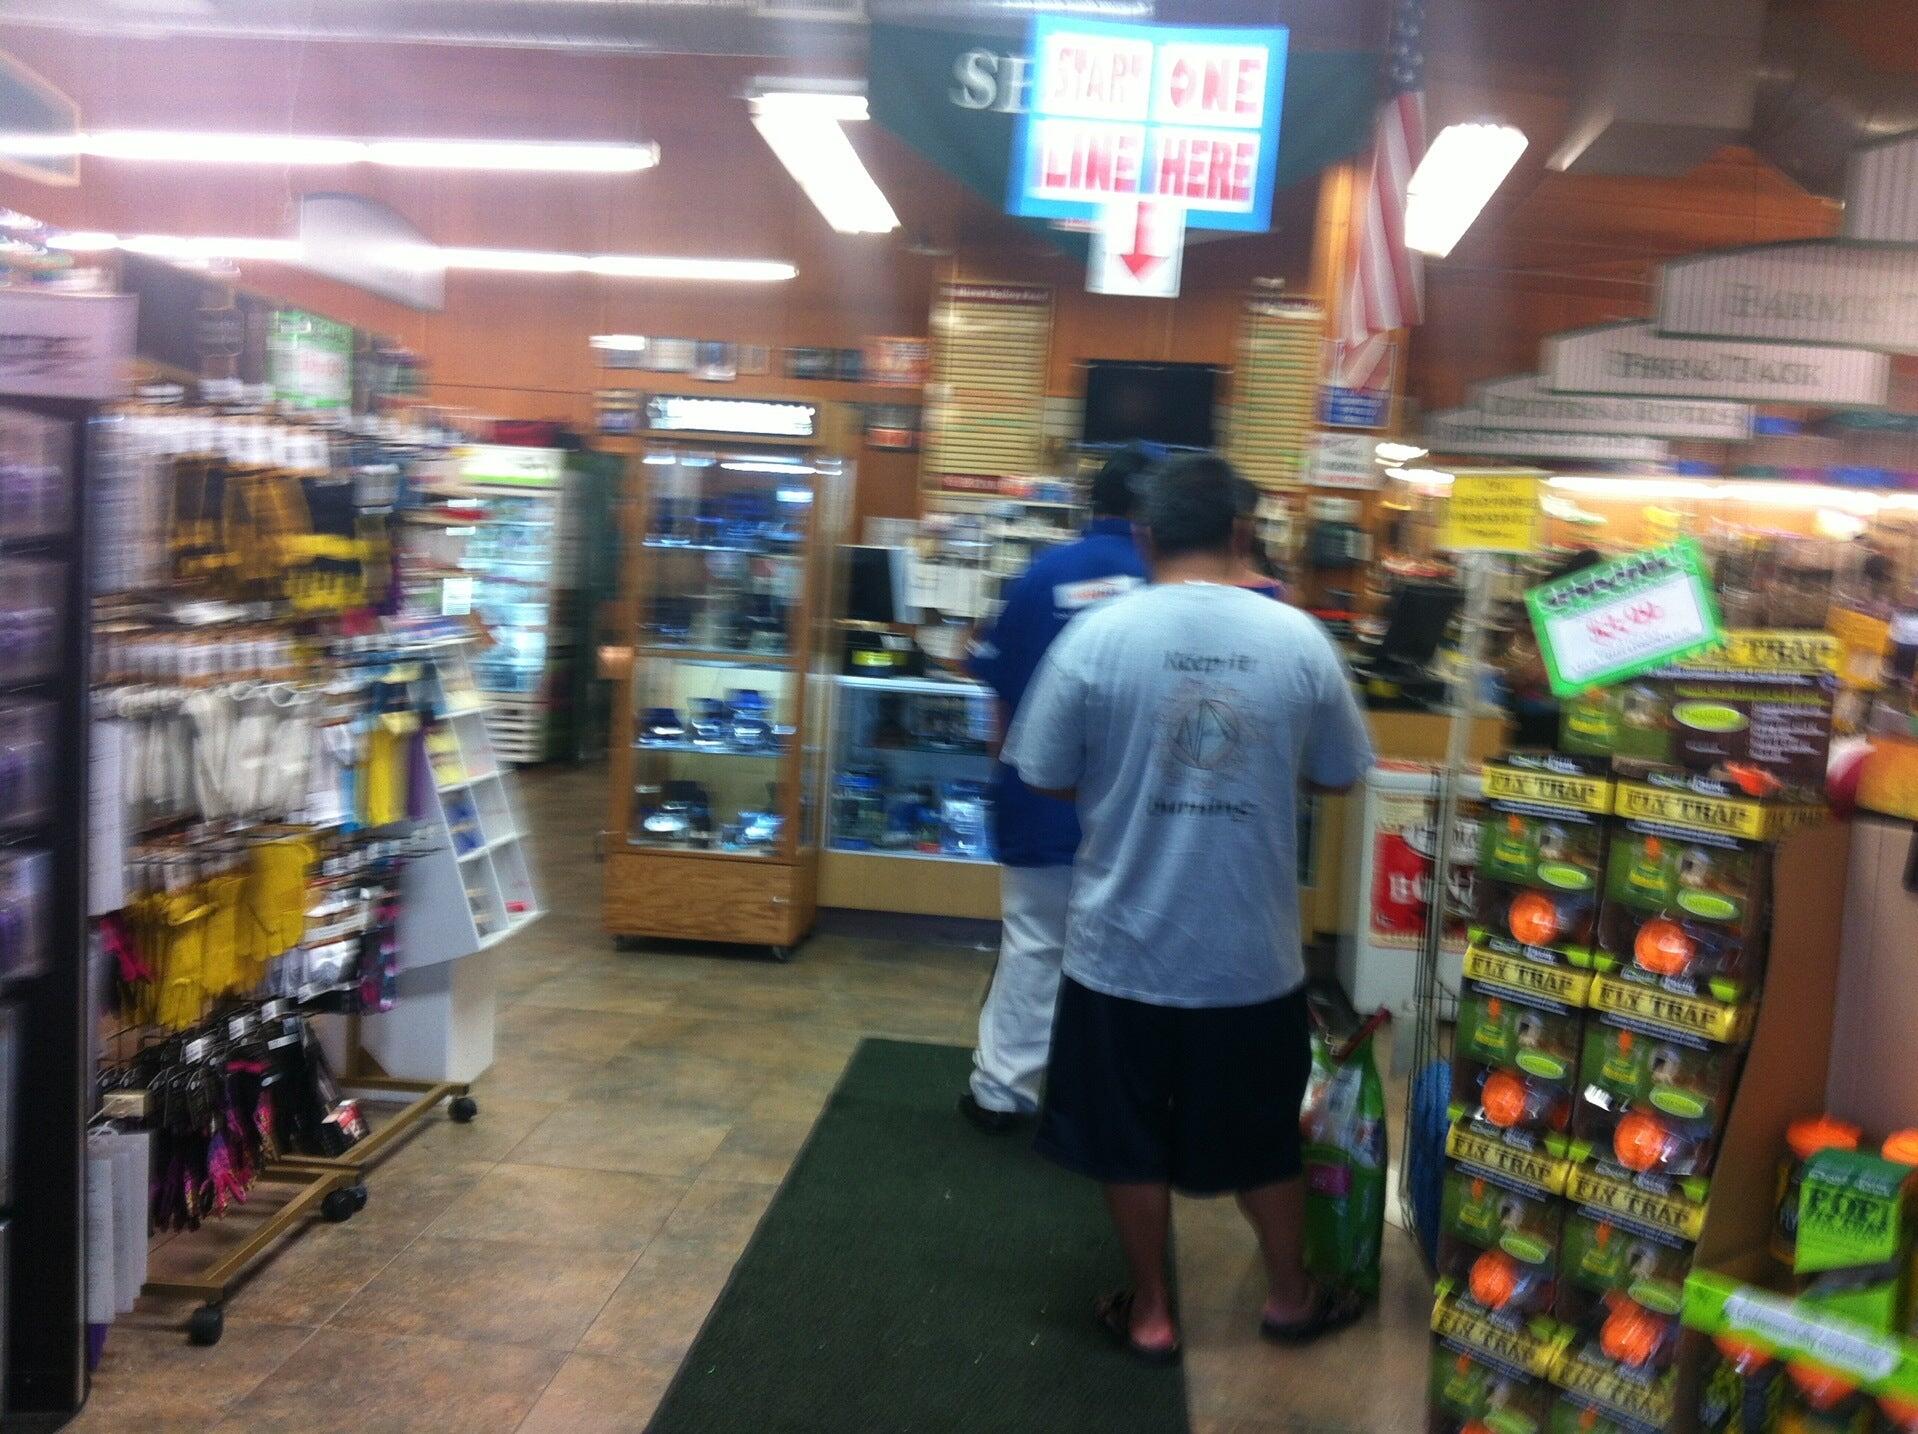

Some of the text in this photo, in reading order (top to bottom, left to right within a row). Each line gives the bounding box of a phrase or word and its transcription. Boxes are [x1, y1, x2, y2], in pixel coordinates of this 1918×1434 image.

[1169, 58, 1261, 114] ONE
[1046, 133, 1255, 201] LINE HERE
[1489, 773, 1596, 803] FLY TRAP
[1626, 790, 1746, 827] FLY TRAP
[1472, 953, 1573, 990] FLY TRAP
[1600, 983, 1639, 1008] FLY
[1652, 994, 1718, 1026] TRAP
[1453, 1135, 1550, 1181] FLY TRAP
[1577, 1178, 1617, 1204] FLY
[1627, 1192, 1690, 1226] TRAP
